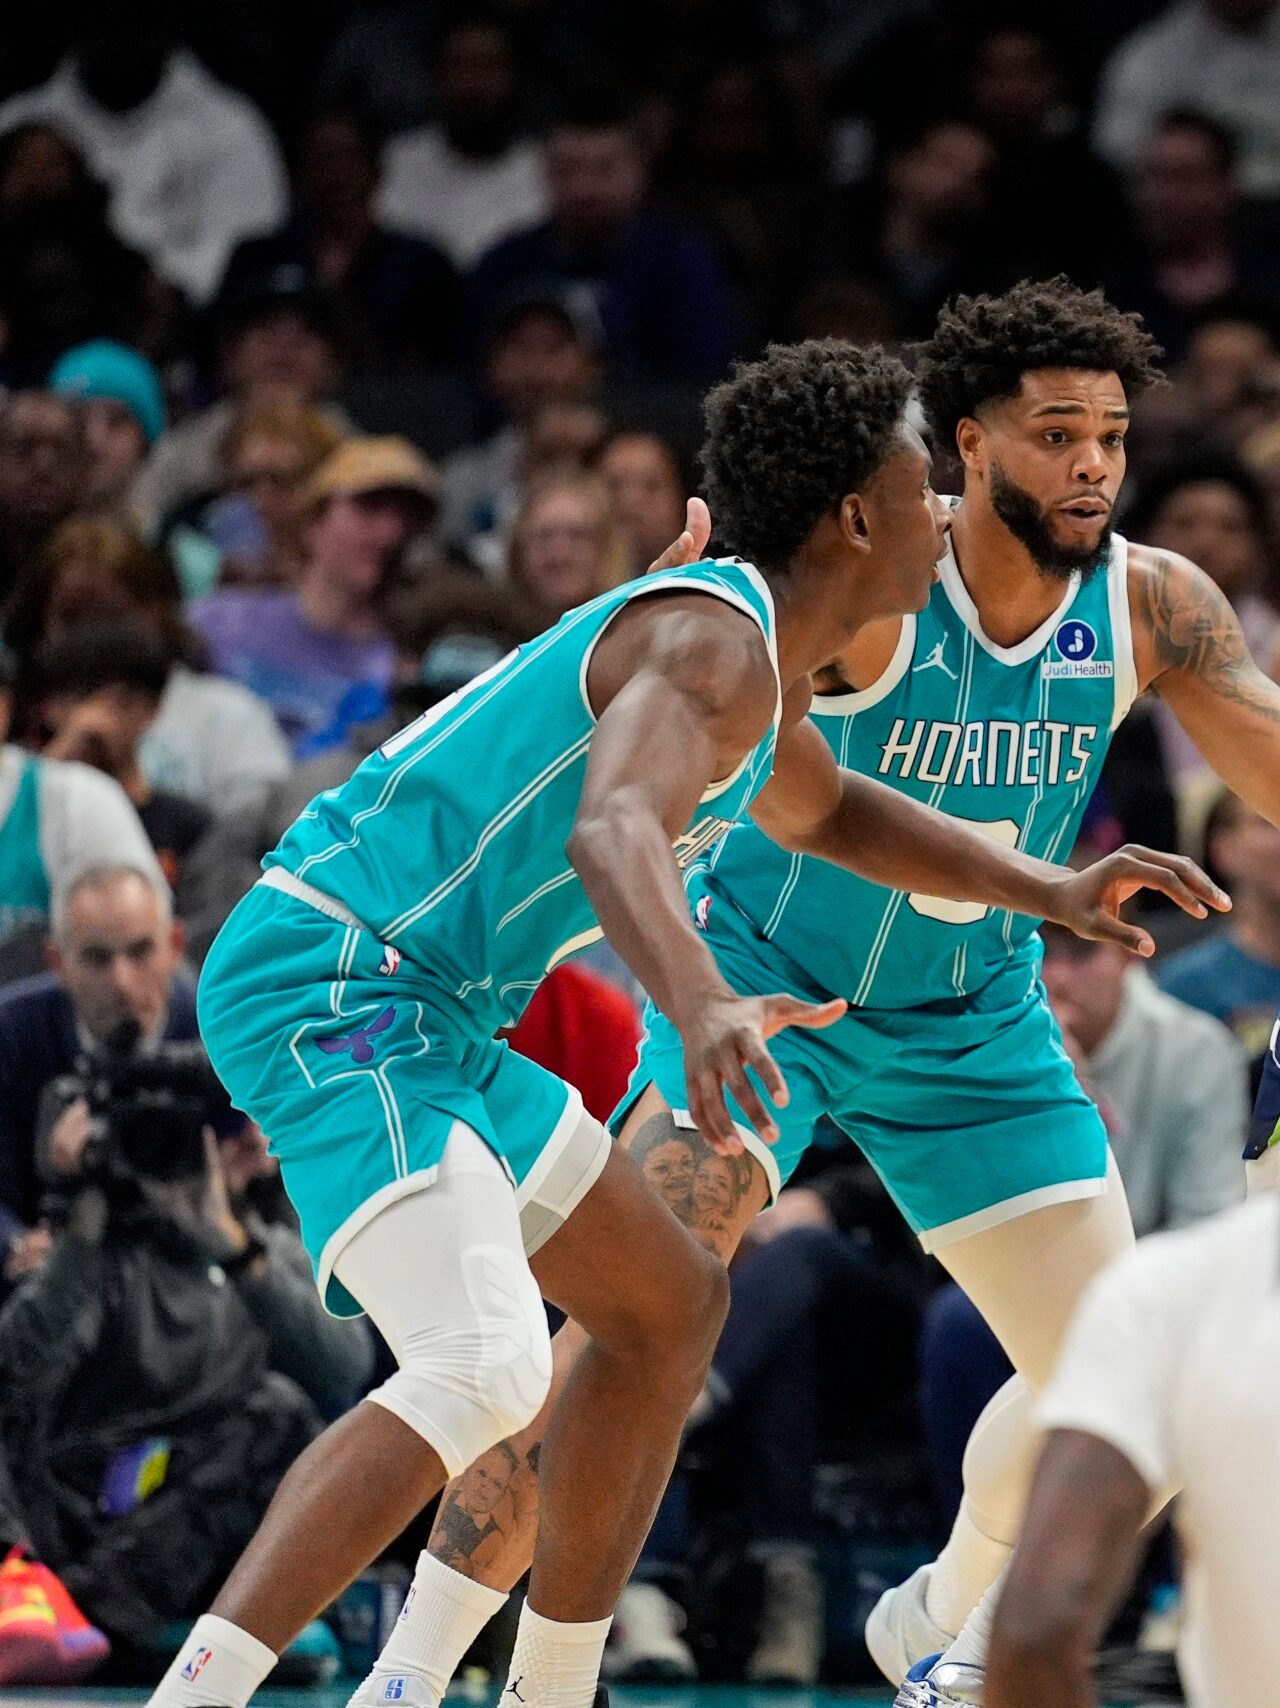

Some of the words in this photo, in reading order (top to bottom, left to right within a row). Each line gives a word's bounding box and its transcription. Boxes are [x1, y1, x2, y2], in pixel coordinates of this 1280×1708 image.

[1045, 664, 1072, 676] Judi
[1074, 663, 1111, 676] Health
[878, 717, 1097, 787] HORNETS
